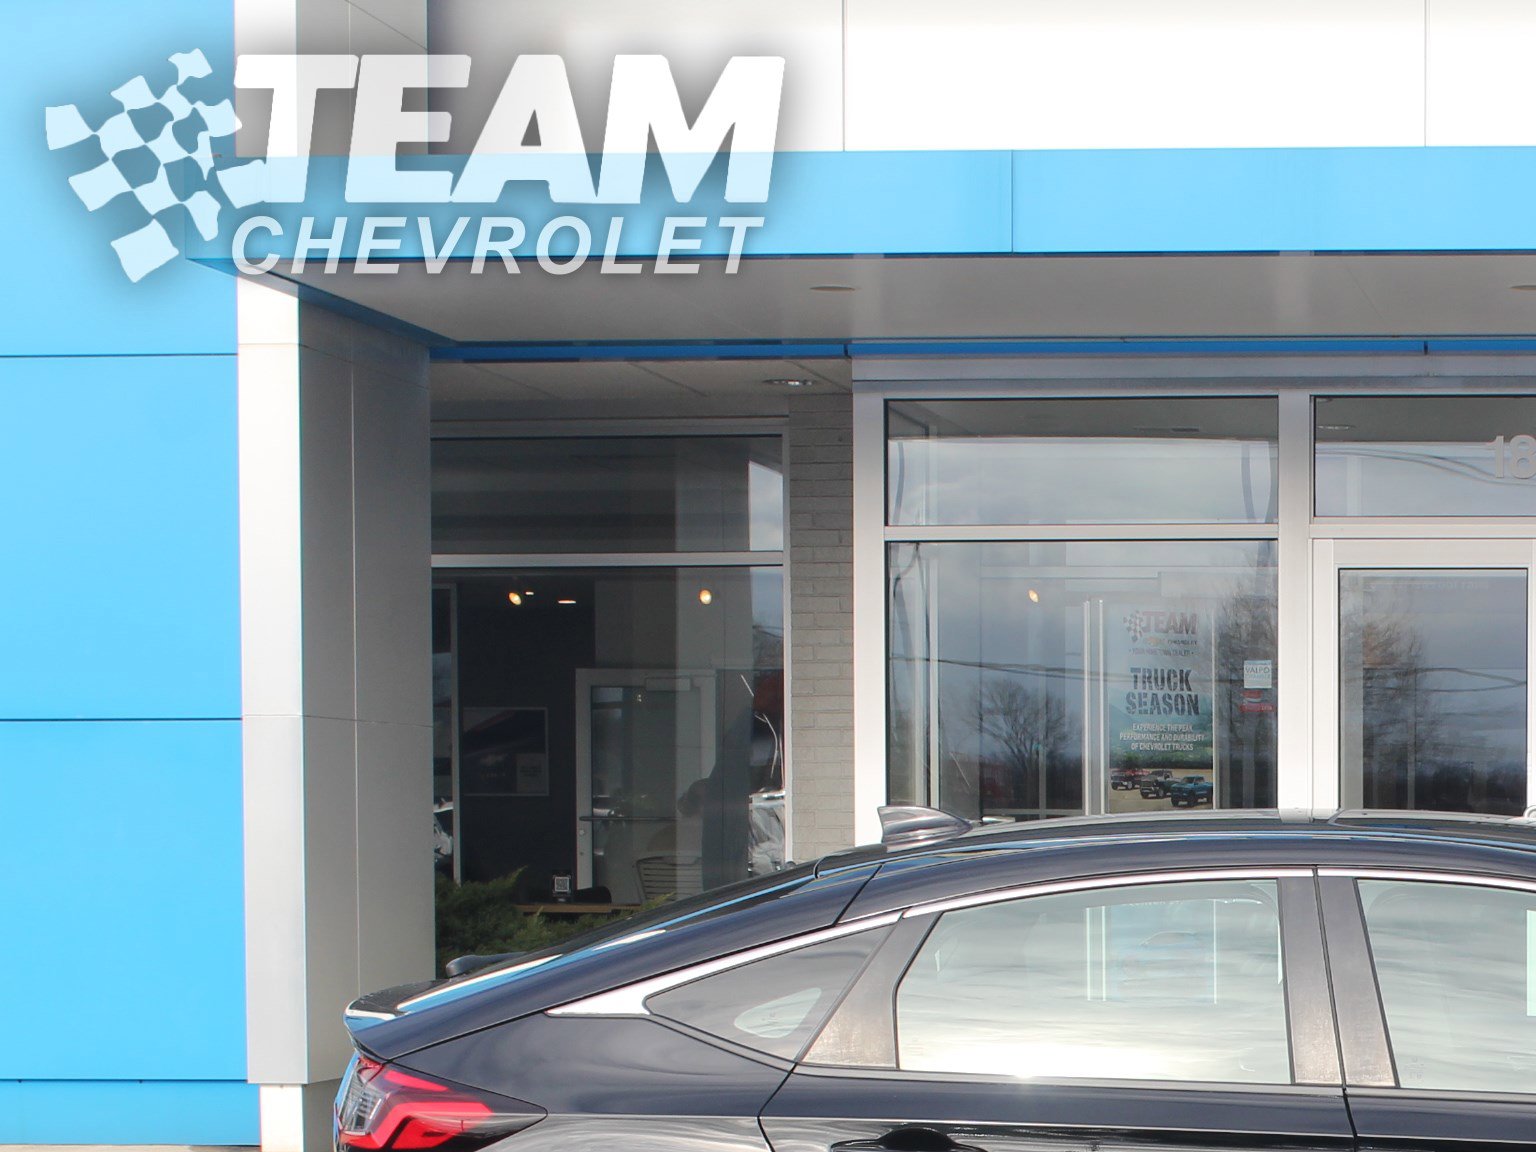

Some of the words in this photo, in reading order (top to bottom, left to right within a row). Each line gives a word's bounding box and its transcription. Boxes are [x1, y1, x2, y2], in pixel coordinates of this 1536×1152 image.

[1140, 611, 1198, 635] TEAM
[1130, 667, 1192, 691] TRUCK
[1126, 692, 1199, 716] SEASON
[1132, 723, 1166, 732] EXPERIENCE
[1119, 732, 1160, 742] PERFORMANCE
[1139, 742, 1170, 751] CHEVROLET
[1171, 742, 1194, 751] TRUCKS
